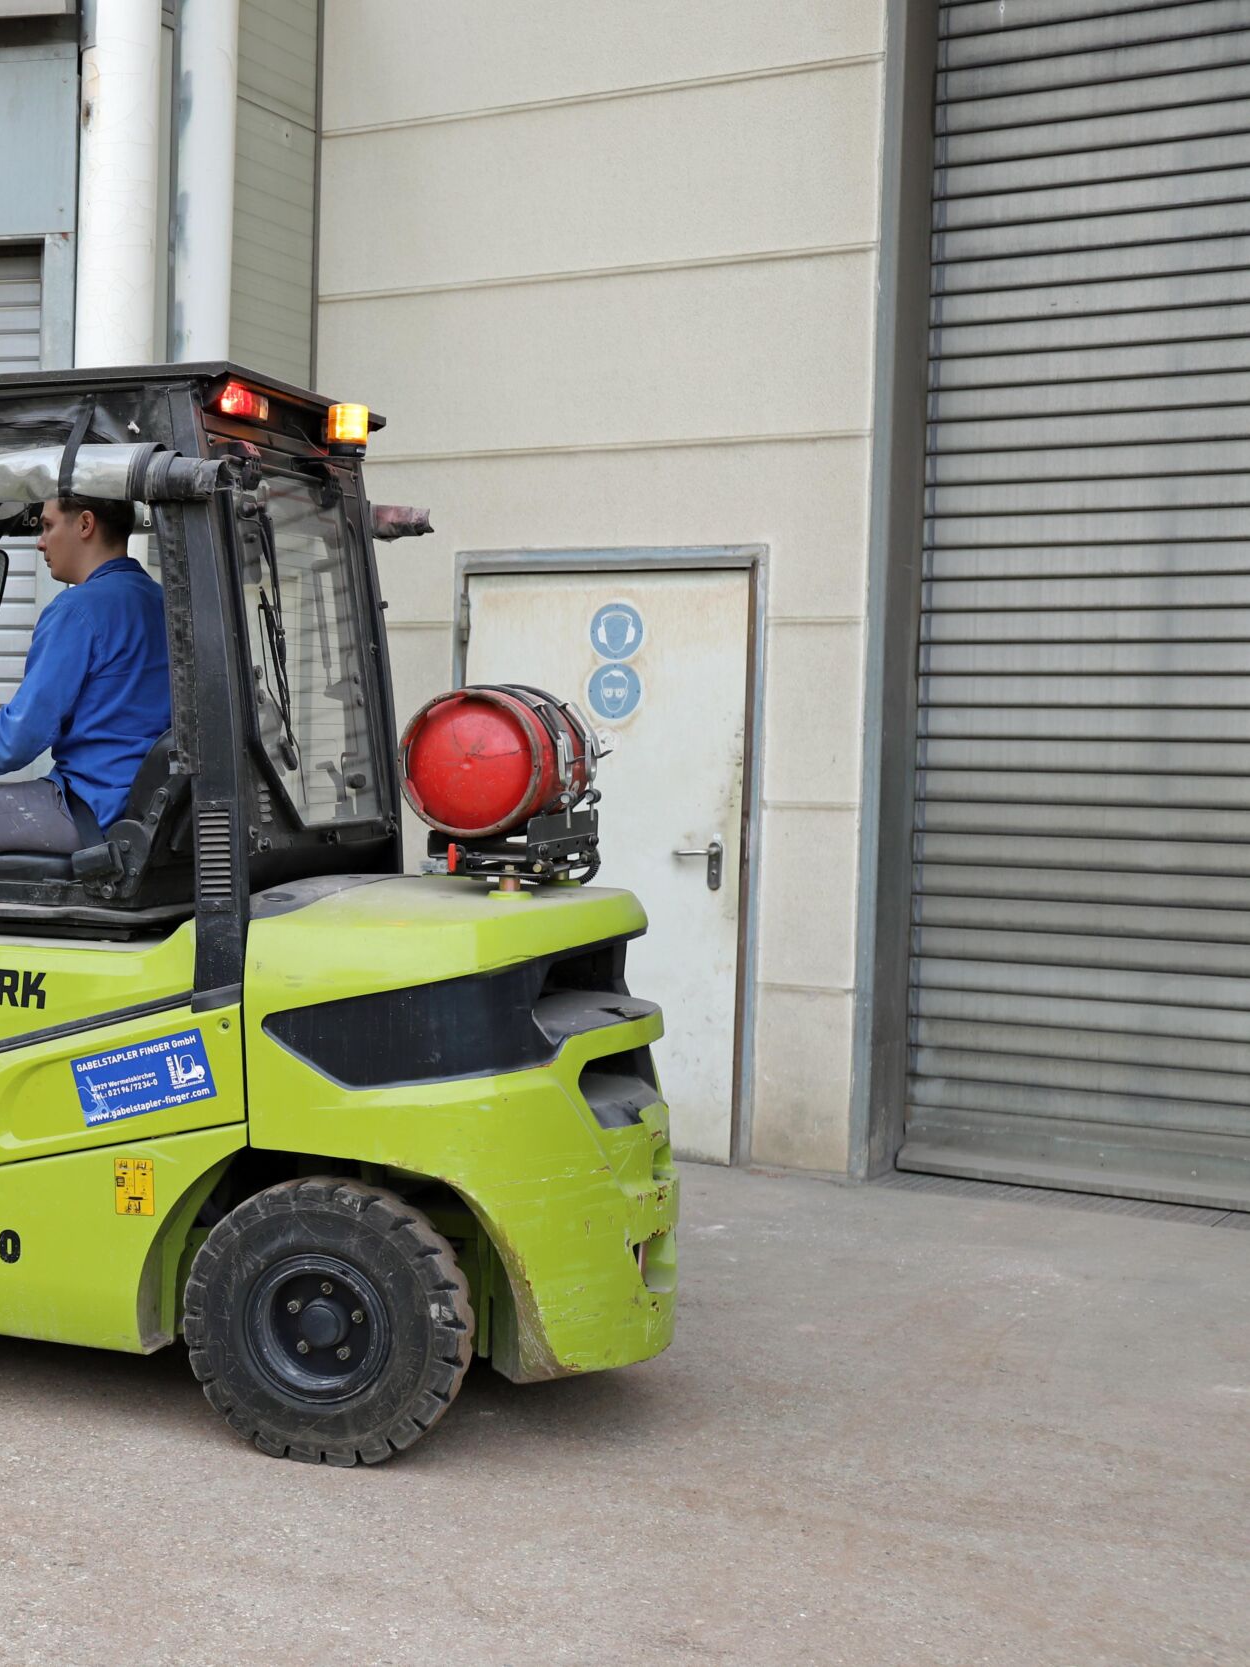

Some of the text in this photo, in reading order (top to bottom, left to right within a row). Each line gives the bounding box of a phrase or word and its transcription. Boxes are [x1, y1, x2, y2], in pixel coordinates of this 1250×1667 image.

[76, 1035, 197, 1072] GABELSTAPLER FINGER GmbH
[165, 1056, 179, 1084] FINGER
[89, 1087, 210, 1122] www.gabelstapler-finger.com
